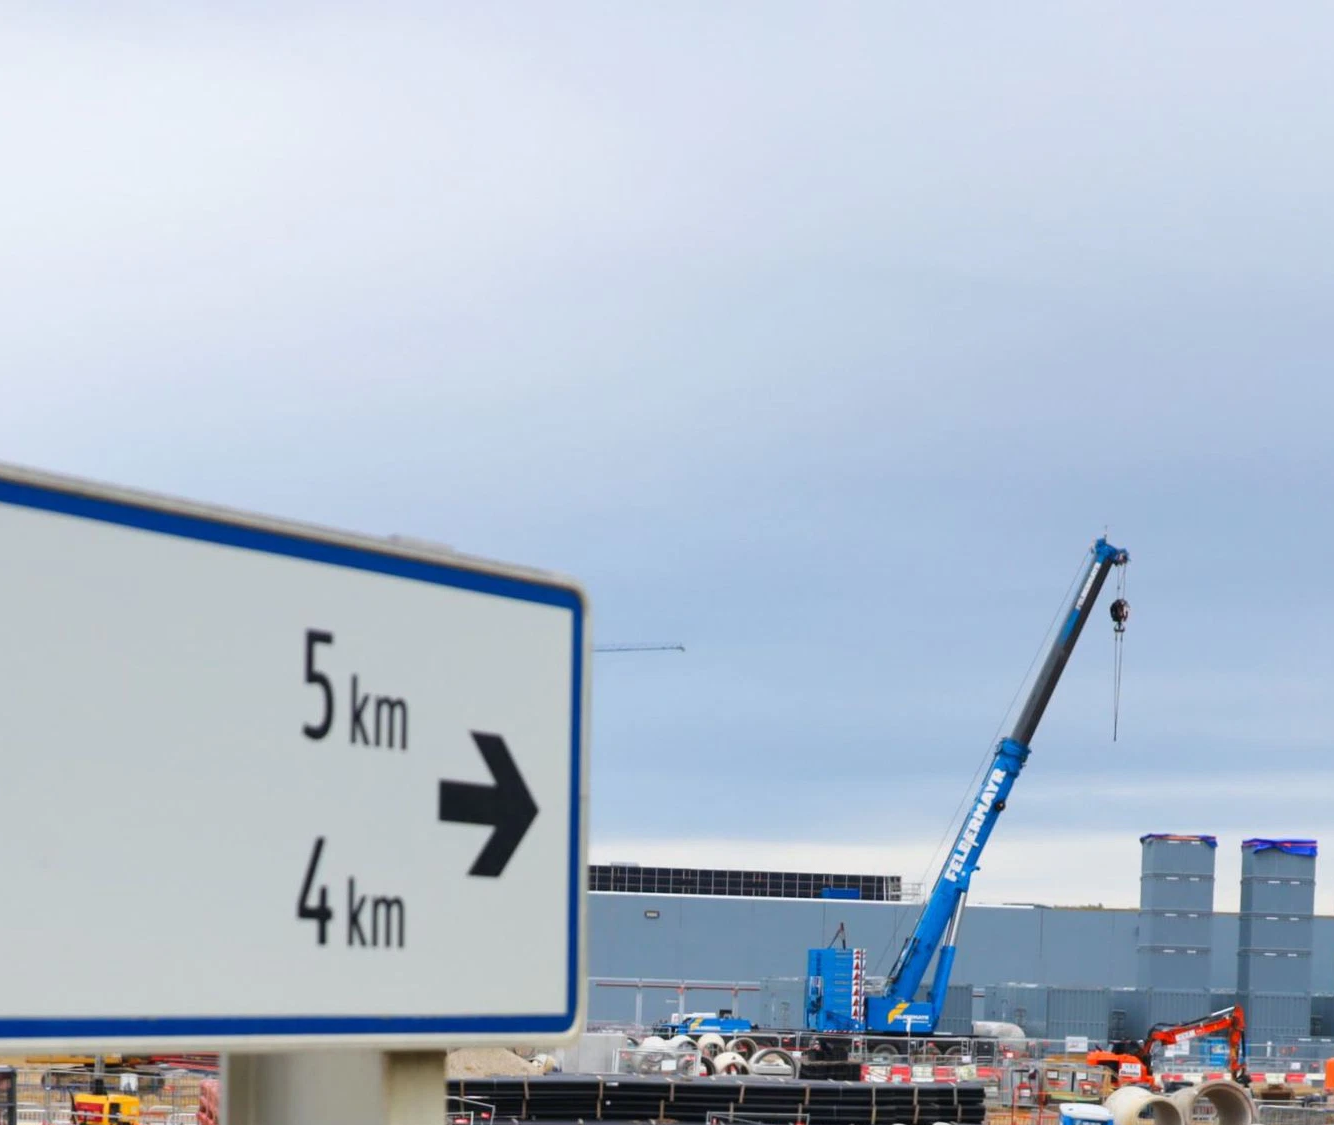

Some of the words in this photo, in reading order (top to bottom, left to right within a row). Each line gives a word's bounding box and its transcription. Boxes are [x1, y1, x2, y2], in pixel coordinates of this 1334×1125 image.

[302, 629, 335, 742] 5
[349, 675, 408, 750] km
[296, 836, 334, 946] 4
[347, 877, 405, 948] km
